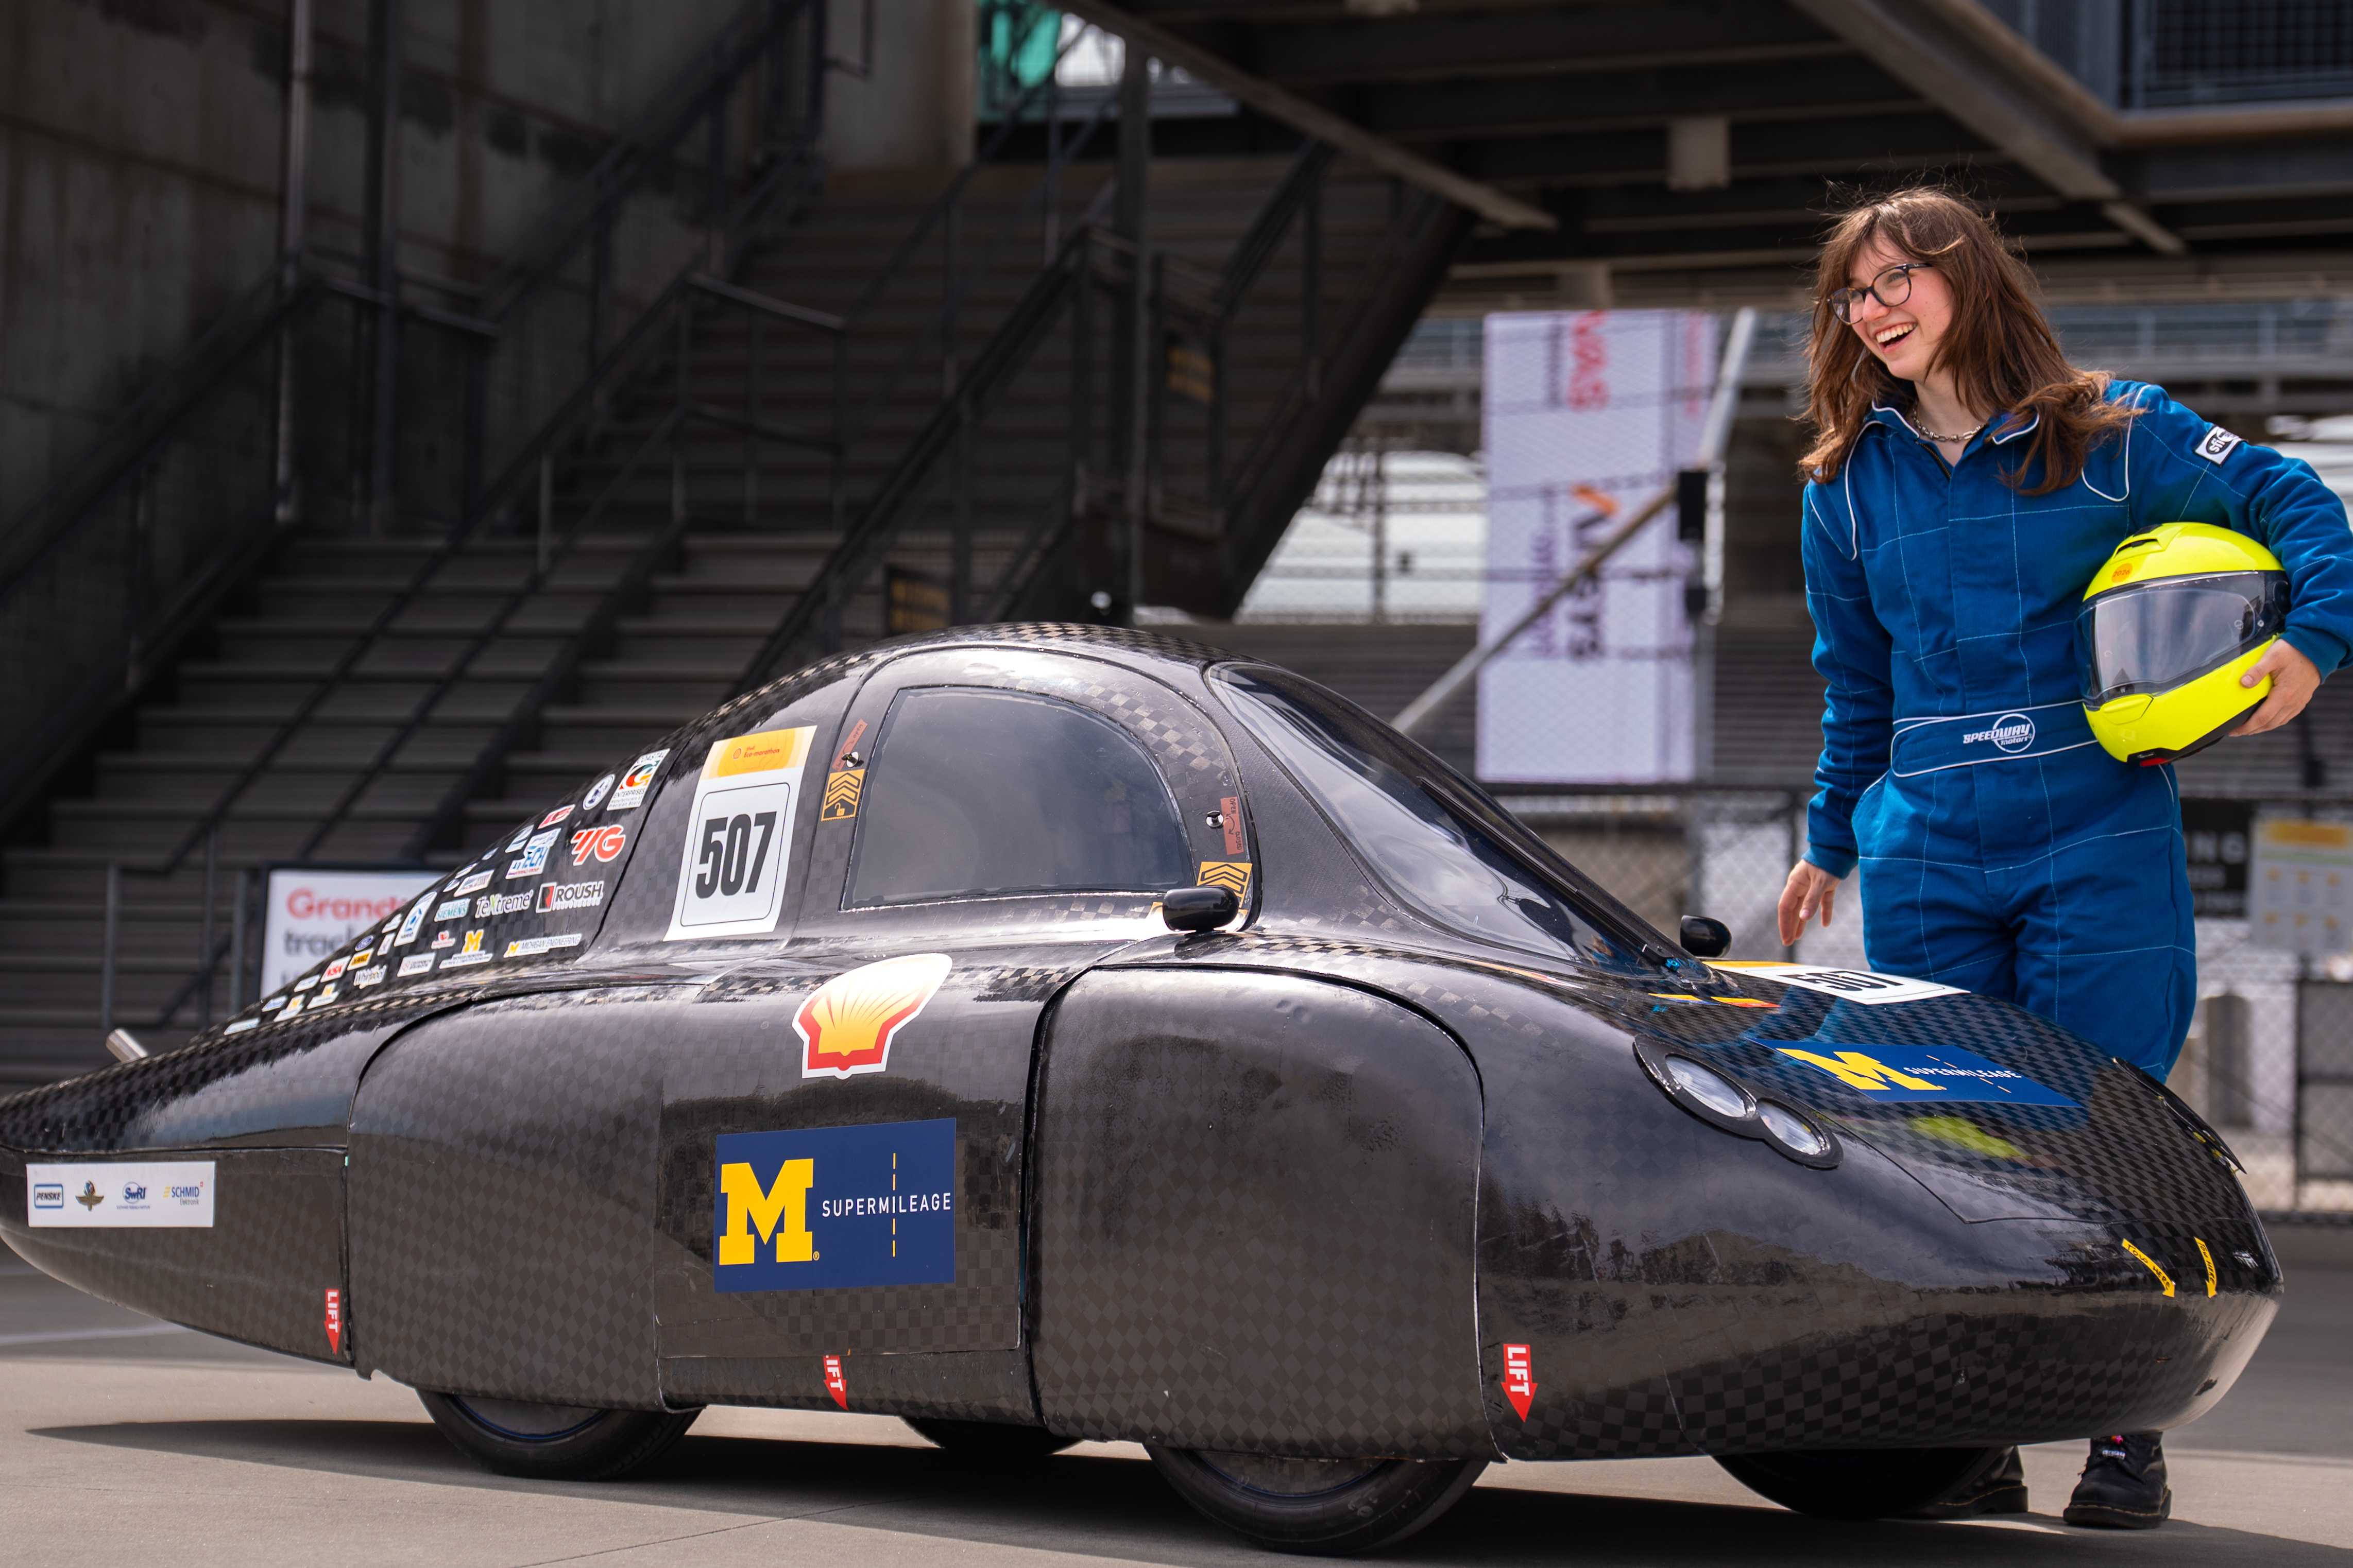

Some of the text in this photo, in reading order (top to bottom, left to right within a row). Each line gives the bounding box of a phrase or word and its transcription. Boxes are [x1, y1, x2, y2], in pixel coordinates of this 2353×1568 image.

[2113, 568, 2130, 577] 2026
[1963, 723, 2031, 744] SPEEDWAY
[2001, 737, 2028, 746] motors
[744, 748, 779, 758] Eco-marathon
[613, 789, 645, 799] ENTERPRISES
[695, 811, 777, 899] 507
[555, 884, 602, 902] ROUSH
[437, 907, 467, 919] SIEMENS
[464, 930, 483, 953] M
[1777, 970, 1905, 991] 507
[1776, 1048, 1942, 1090] M
[1903, 1067, 2022, 1078] SUPERMILEAGE
[36, 1192, 61, 1201] PENSKE
[124, 1187, 146, 1199] SwRI
[171, 1186, 199, 1198] SCHMID
[719, 1158, 814, 1265] M
[822, 1193, 951, 1217] SUPERMILEAGE
[2153, 1265, 2170, 1290] HERE
[2206, 1260, 2215, 1285] HERE
[328, 1291, 338, 1333] LIFT
[826, 1355, 843, 1391] IFT
[1507, 1347, 1530, 1397] LIFT
